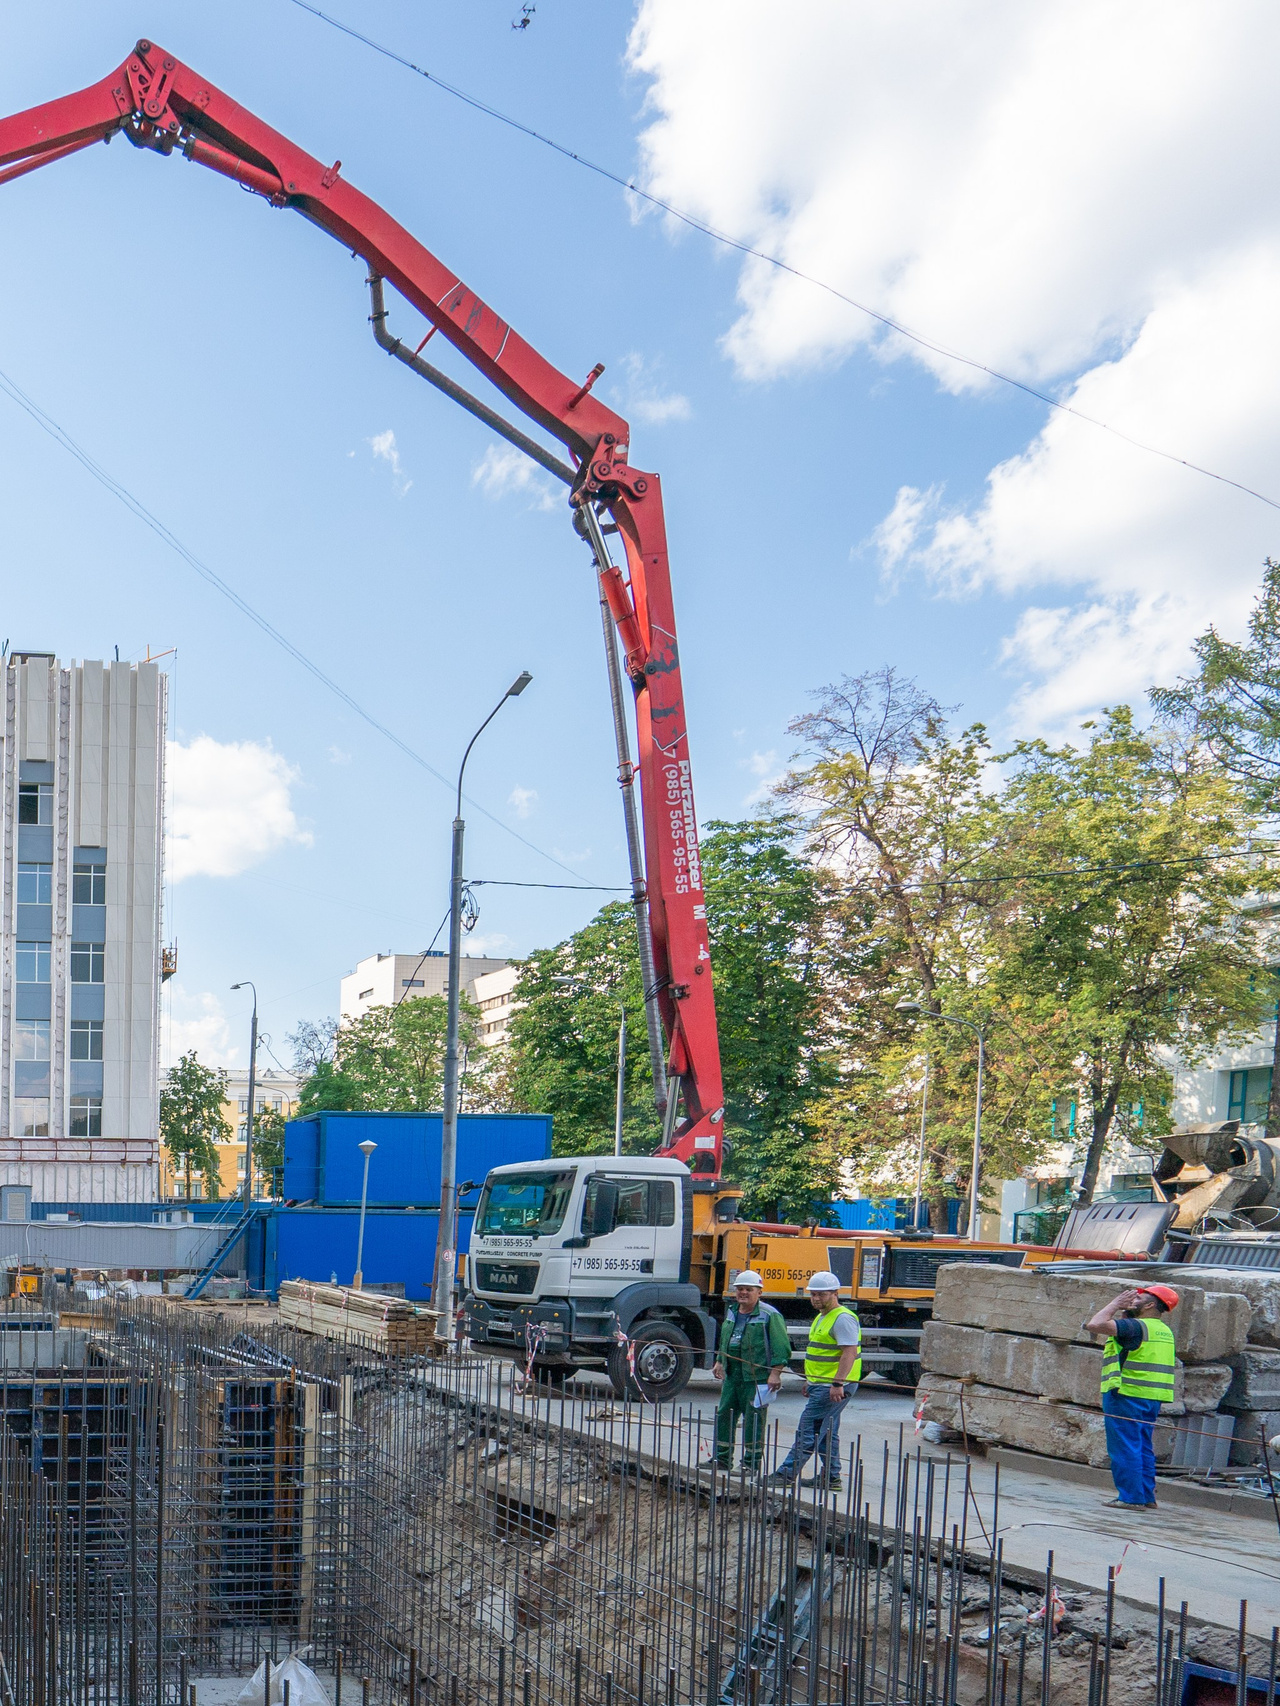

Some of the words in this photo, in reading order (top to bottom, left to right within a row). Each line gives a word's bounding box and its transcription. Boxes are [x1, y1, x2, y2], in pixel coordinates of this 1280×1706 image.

[662, 764, 681, 805] (985)
[678, 760, 701, 890] Putzmeister
[670, 810, 688, 894] 565-95-55
[503, 1239, 533, 1248] 565-95-55
[572, 1258, 582, 1269] +7
[584, 1258, 602, 1270] (985)
[604, 1258, 640, 1271] 565-95-55
[489, 1273, 518, 1284] MAN
[763, 1268, 784, 1280] (985)
